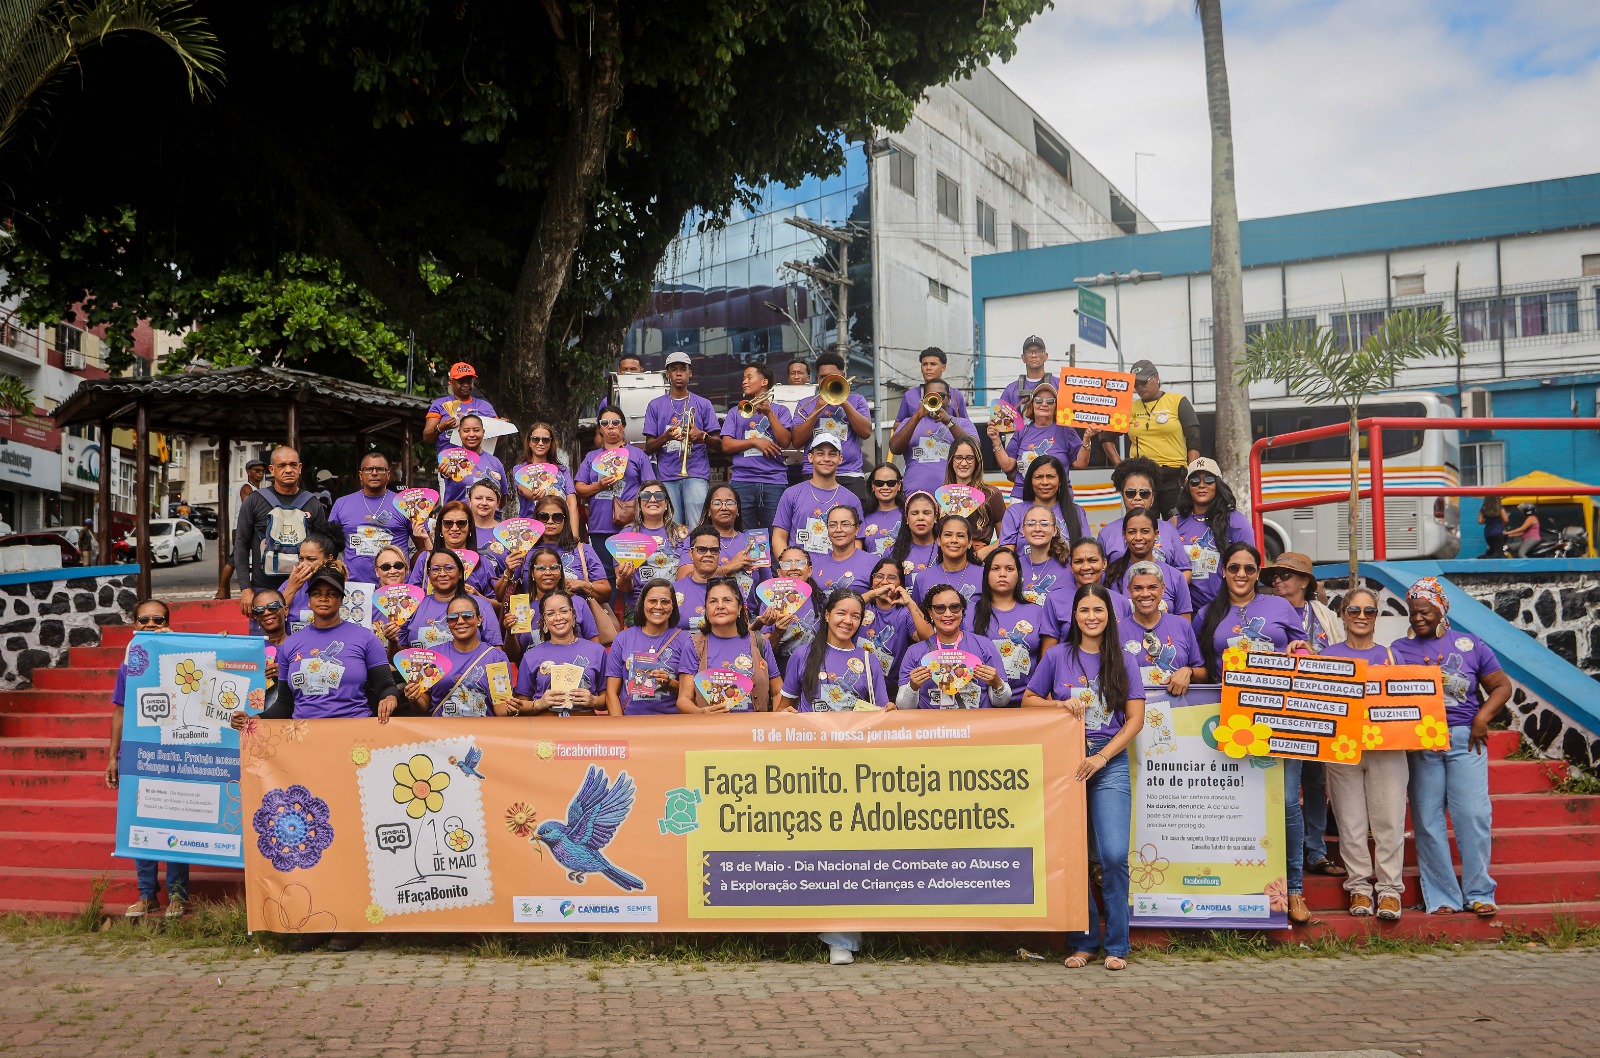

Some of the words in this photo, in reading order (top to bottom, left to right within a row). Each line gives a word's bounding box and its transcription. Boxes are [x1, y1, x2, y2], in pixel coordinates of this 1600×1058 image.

[1076, 395, 1115, 404] CAMPANHA
[1250, 655, 1291, 667] CARTÃO
[1300, 660, 1352, 672] VERMELHO
[1226, 674, 1252, 683] PARA
[1255, 676, 1290, 687] ABUSO
[1390, 684, 1429, 692] BONITO!
[146, 704, 166, 712] 100
[1241, 694, 1282, 706] CONTRA
[1288, 700, 1336, 712] CRIANÇAS
[206, 706, 214, 718] DE
[216, 710, 232, 722] MAI
[1374, 710, 1418, 719] BUZINE!!!
[1256, 716, 1333, 730] ADOLESCENTES.
[172, 730, 208, 742] #FaçaBonito
[751, 728, 764, 742] 18
[768, 728, 782, 742] de
[785, 728, 816, 742] Maio:
[820, 732, 828, 742] a
[830, 730, 865, 742] nossa
[866, 728, 912, 743] jornada
[916, 725, 971, 740] continua!
[556, 743, 626, 759] facabonito.org
[1272, 740, 1316, 752] BUZINE!!!
[138, 748, 154, 762] Faça
[184, 752, 213, 765] Proteja
[136, 760, 170, 774] Crianças
[177, 764, 230, 778] Adolescentes.
[1146, 760, 1206, 772] Denunciar
[1210, 760, 1217, 772] é
[1222, 763, 1239, 772] um
[704, 765, 758, 802] Faça
[765, 764, 848, 794] Bonito.
[856, 763, 941, 798] Proteja
[948, 767, 1030, 792] nossas
[1146, 776, 1164, 786] ato
[1170, 776, 1183, 786] de
[1188, 776, 1244, 790] proteção!
[719, 804, 822, 840] Crianças
[830, 812, 842, 832] e
[850, 801, 1016, 832] Adolescentes.
[180, 840, 209, 848] CANDEIAS
[382, 834, 406, 844] 100
[433, 857, 447, 872] DE
[449, 854, 477, 870] MAIO
[720, 861, 734, 872] 18
[736, 861, 752, 872] de
[754, 860, 784, 872] Maio
[794, 860, 814, 872] Dia
[818, 860, 870, 872] Nacional
[874, 860, 890, 871] de
[892, 859, 948, 871] Combate
[951, 862, 966, 870] ao
[969, 858, 1008, 870] Abuso
[1012, 861, 1020, 870] e
[720, 880, 728, 891] à
[730, 879, 798, 894] Exploração
[800, 878, 840, 890] Sexual
[842, 878, 860, 890] de
[862, 878, 914, 892] Crianças
[916, 881, 925, 890] e
[928, 877, 1011, 890] Adolescentes
[397, 886, 468, 906] #FaçaBonito
